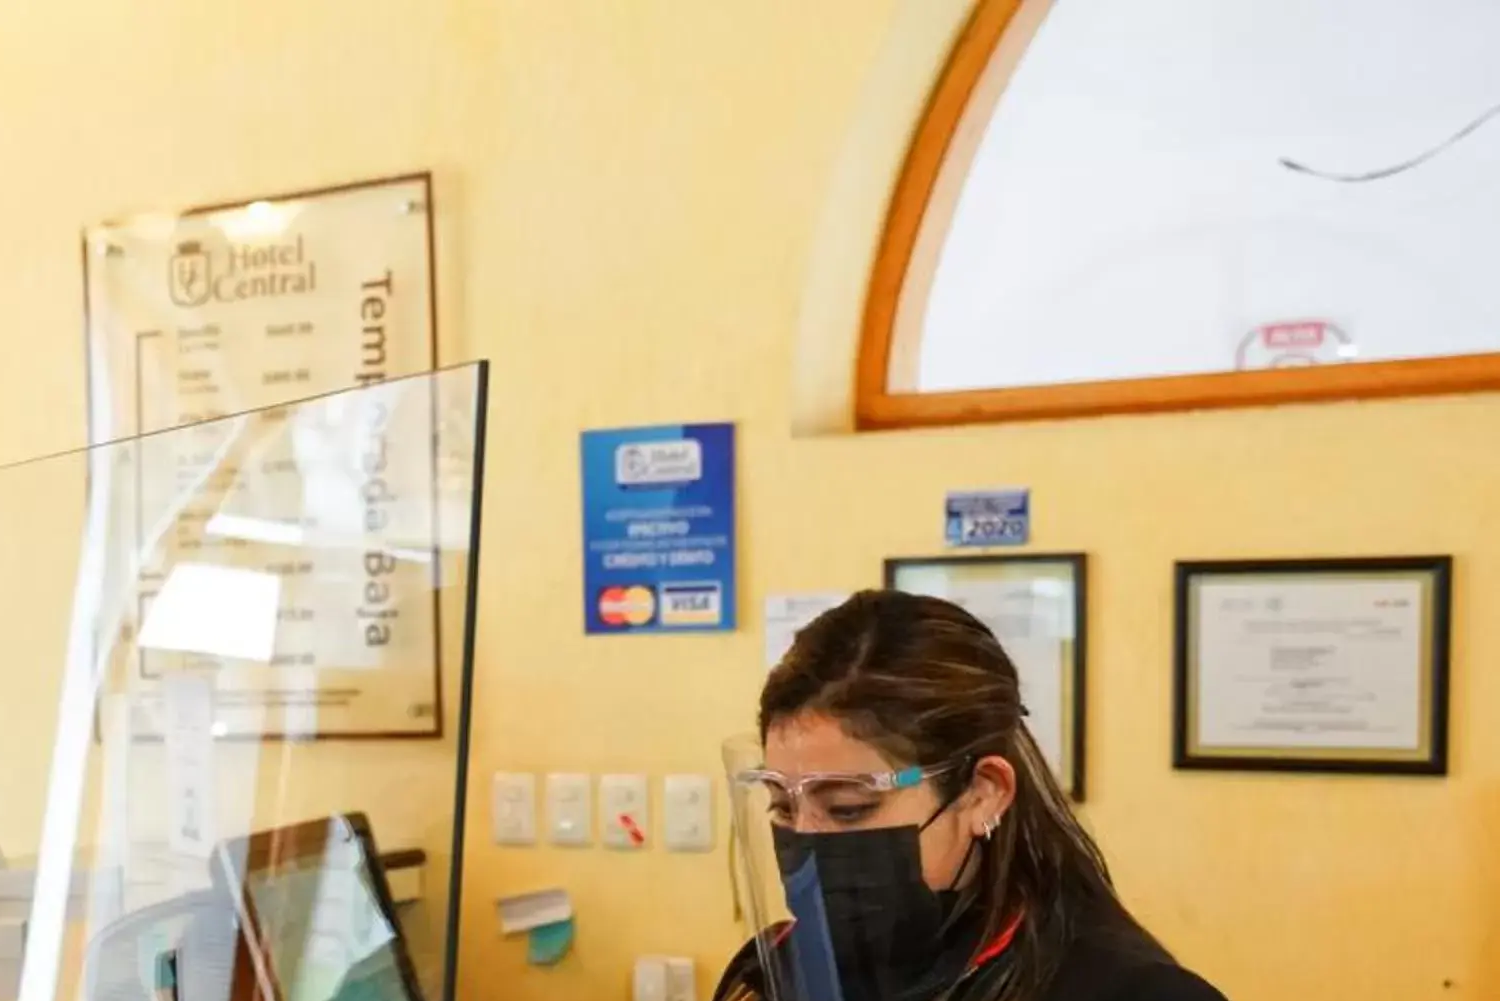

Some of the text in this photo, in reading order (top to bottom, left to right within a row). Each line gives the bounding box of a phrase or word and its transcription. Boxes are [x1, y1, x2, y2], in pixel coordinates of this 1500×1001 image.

[226, 234, 304, 277] Hotel
[212, 260, 316, 303] Central
[357, 549, 400, 648] Baja
[671, 595, 711, 611] VISA
